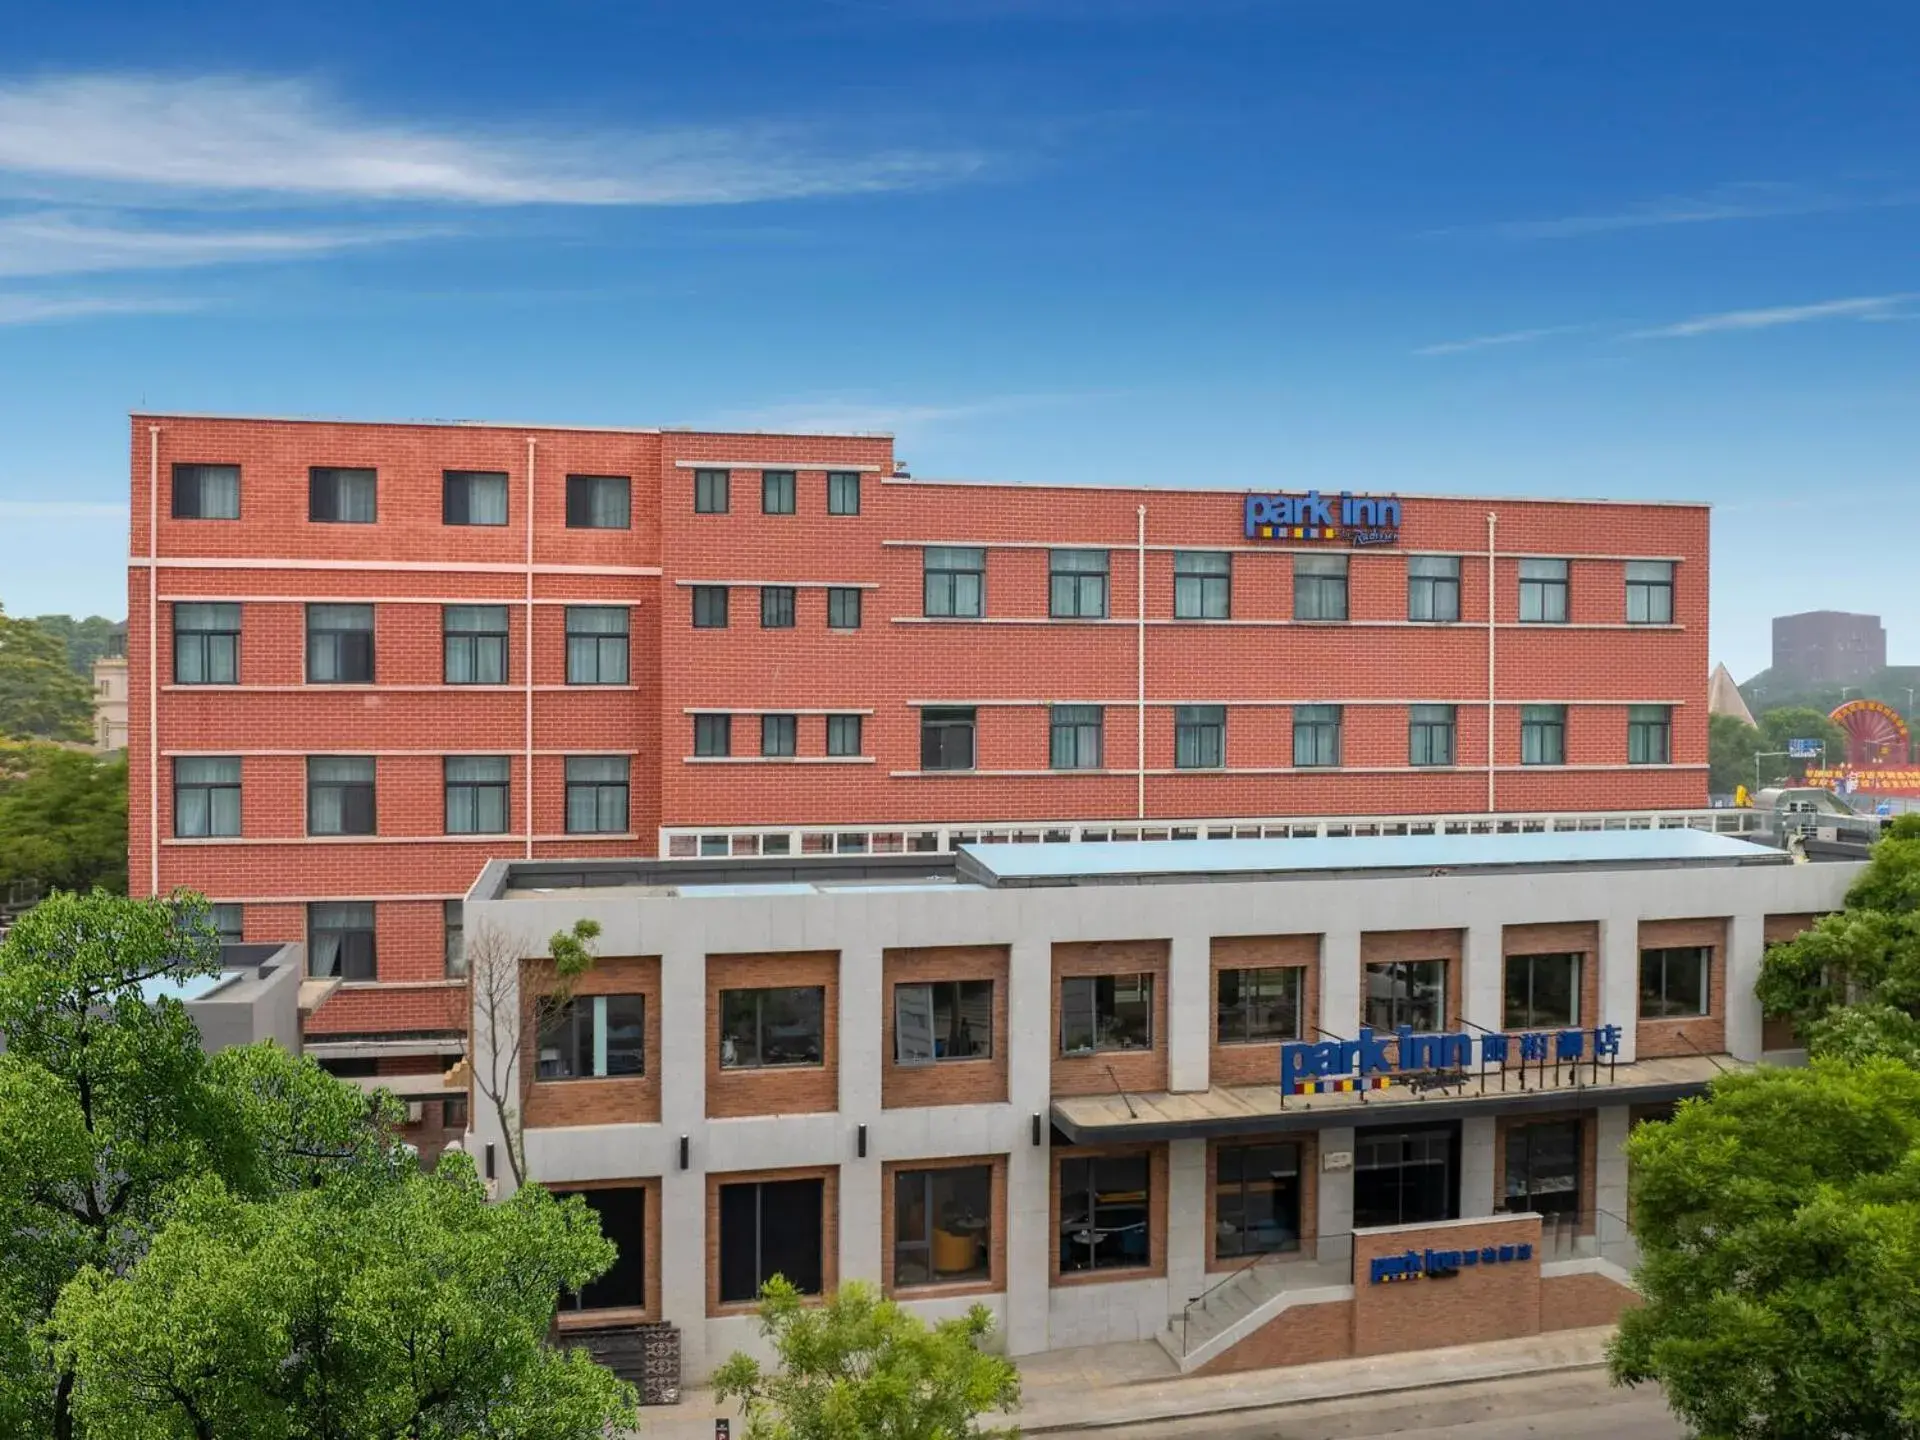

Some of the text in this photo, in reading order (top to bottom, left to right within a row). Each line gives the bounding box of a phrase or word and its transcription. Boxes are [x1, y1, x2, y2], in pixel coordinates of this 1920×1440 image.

[1245, 490, 1401, 538] park inn
[1281, 1027, 1392, 1096] park
[1397, 1025, 1472, 1069] inn
